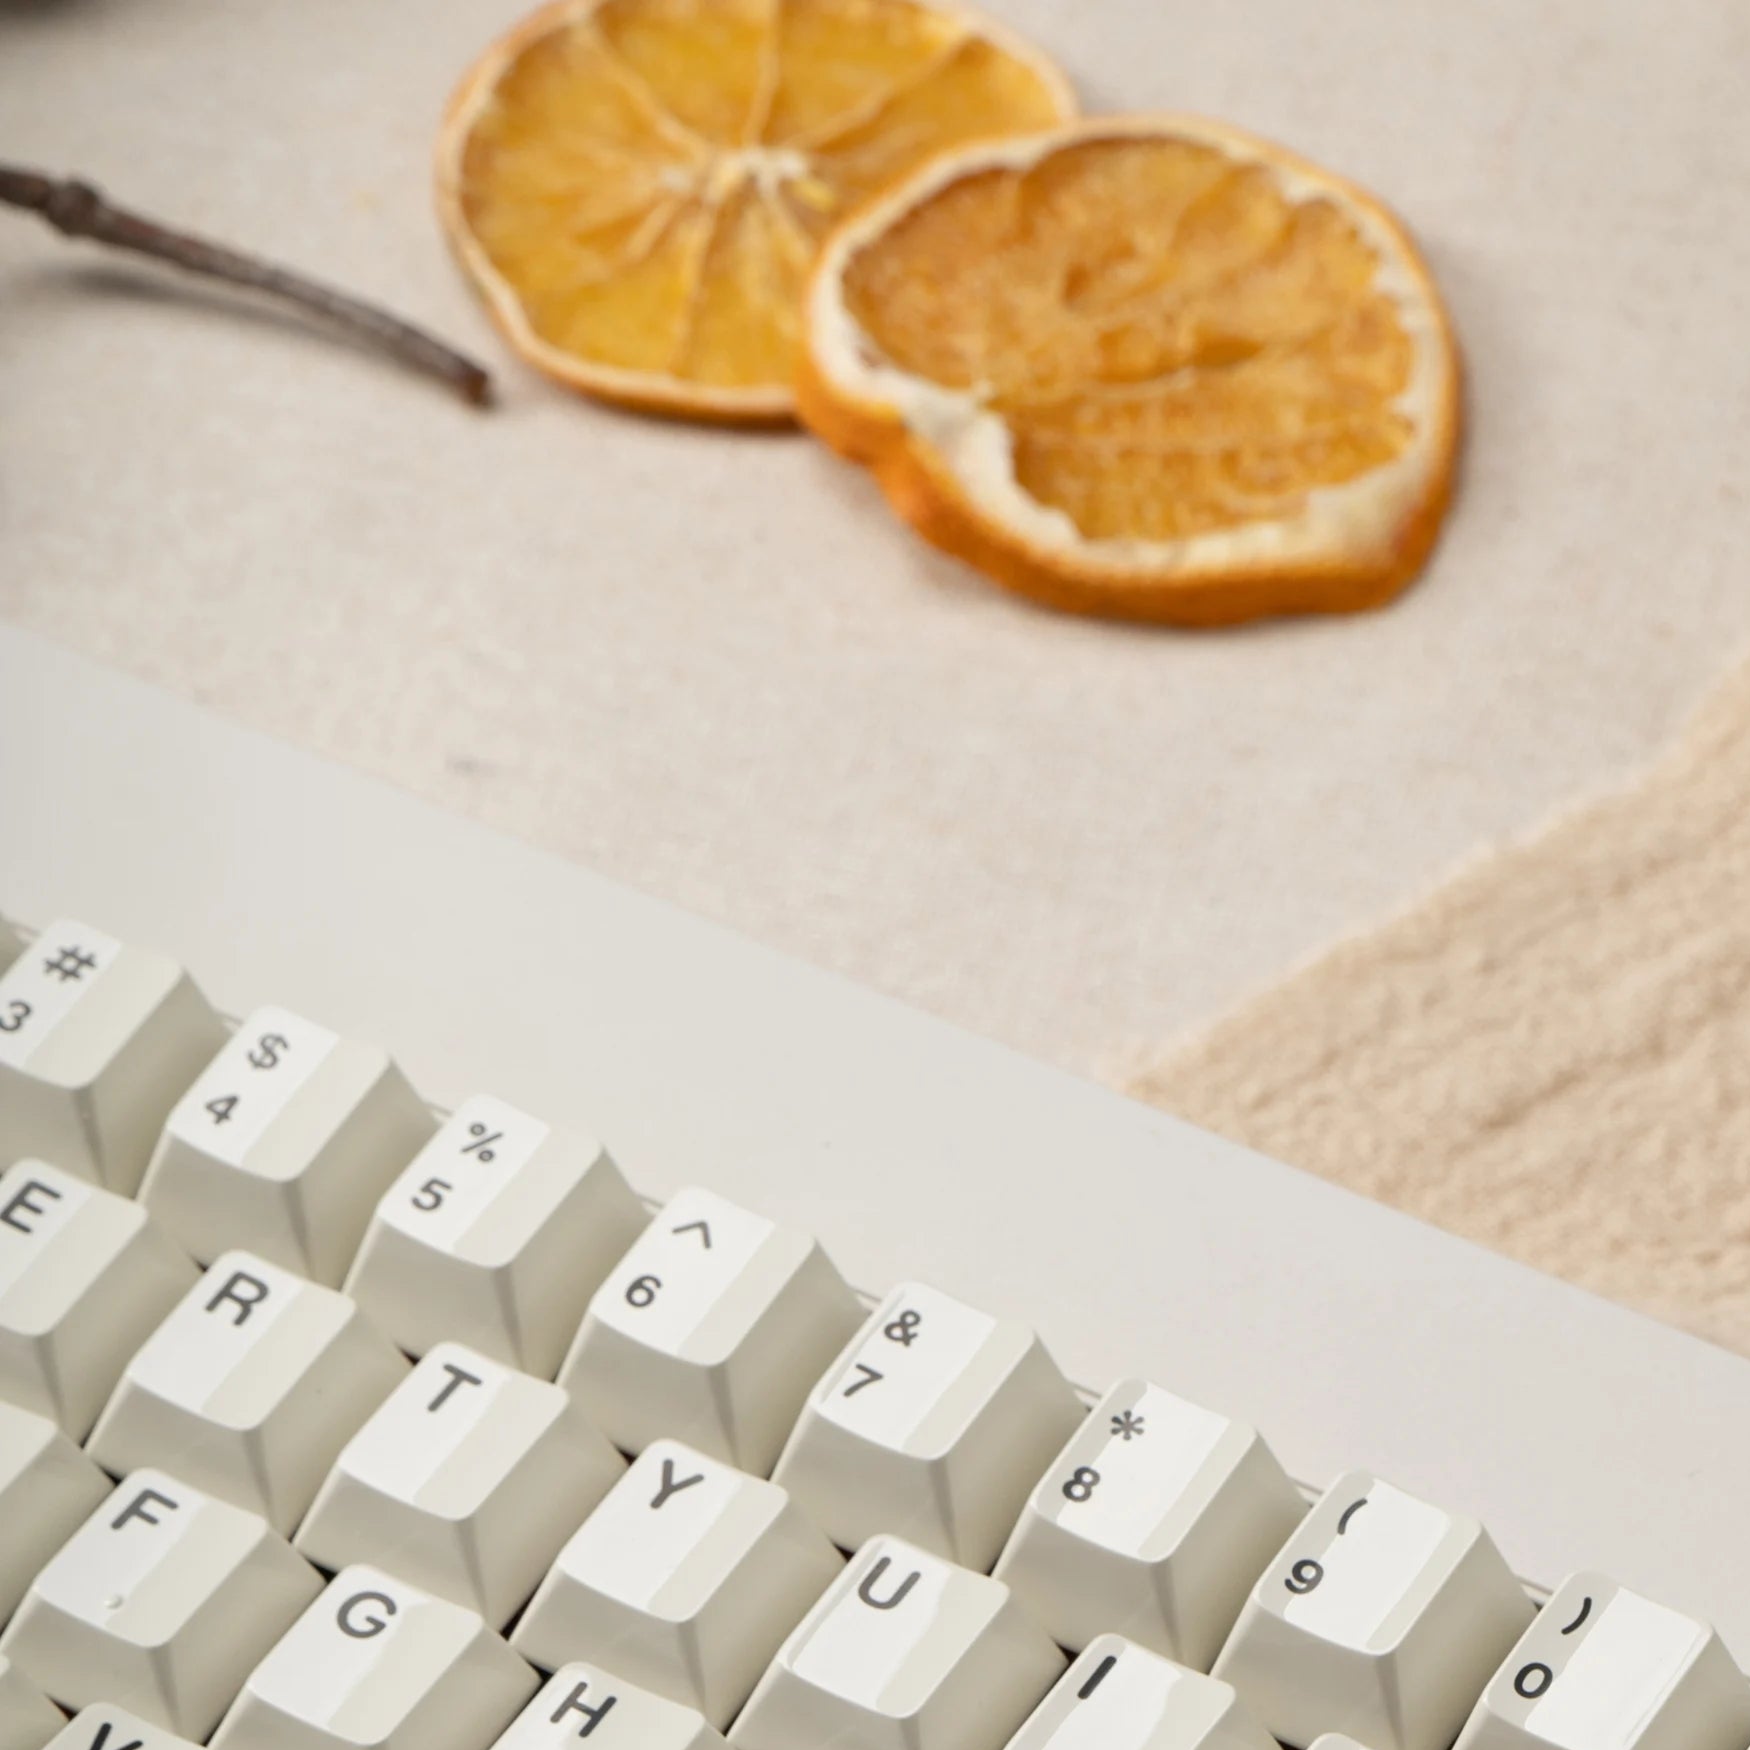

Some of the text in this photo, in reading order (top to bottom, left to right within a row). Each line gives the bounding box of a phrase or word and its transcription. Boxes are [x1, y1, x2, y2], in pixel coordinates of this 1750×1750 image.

[45, 947, 95, 981] #
[0, 1001, 32, 1032] 3
[247, 1034, 288, 1069] $
[206, 1096, 239, 1124] 4
[462, 1123, 502, 1162] %
[0, 1181, 61, 1233] E
[412, 1178, 452, 1211] 5
[672, 1221, 711, 1249] ^
[206, 1271, 270, 1325] R
[625, 1275, 661, 1307] 6
[884, 1310, 921, 1346] &
[428, 1364, 482, 1412] T
[844, 1364, 883, 1397] 7
[650, 1459, 704, 1509] Y
[1062, 1466, 1100, 1502] 8
[112, 1487, 178, 1530] F
[1337, 1498, 1367, 1535] (
[858, 1557, 920, 1610] U
[1285, 1559, 1323, 1594] 9
[337, 1592, 396, 1638] G
[1562, 1597, 1592, 1635] )
[1077, 1655, 1117, 1699] I
[549, 1682, 617, 1738] H
